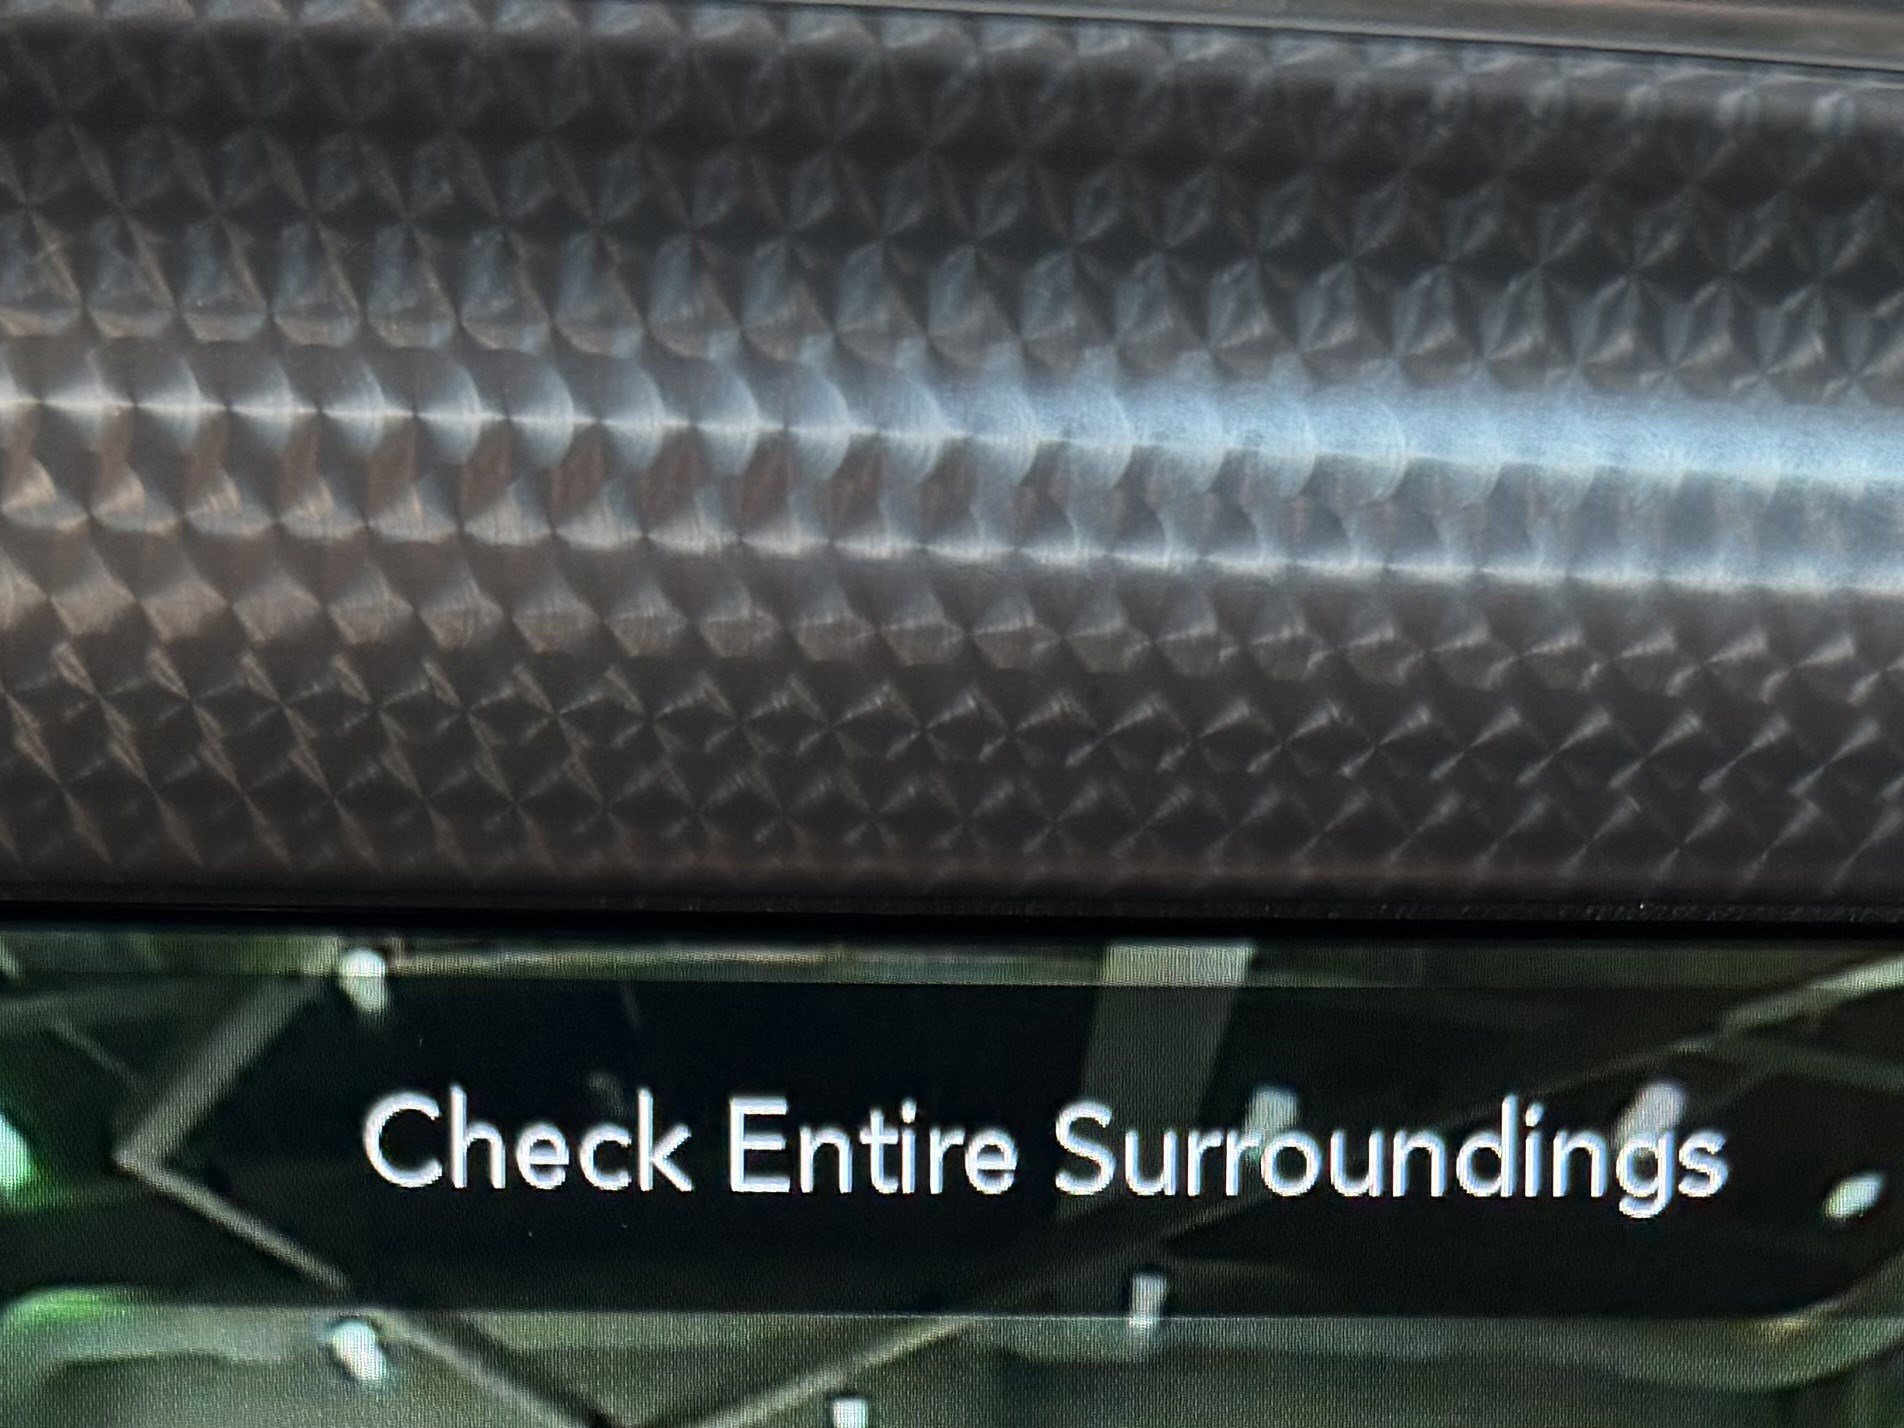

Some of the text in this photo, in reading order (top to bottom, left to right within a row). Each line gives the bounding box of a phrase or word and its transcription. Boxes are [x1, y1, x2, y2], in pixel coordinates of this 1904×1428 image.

[362, 1085, 1728, 1219] Check Entire Surroundings
